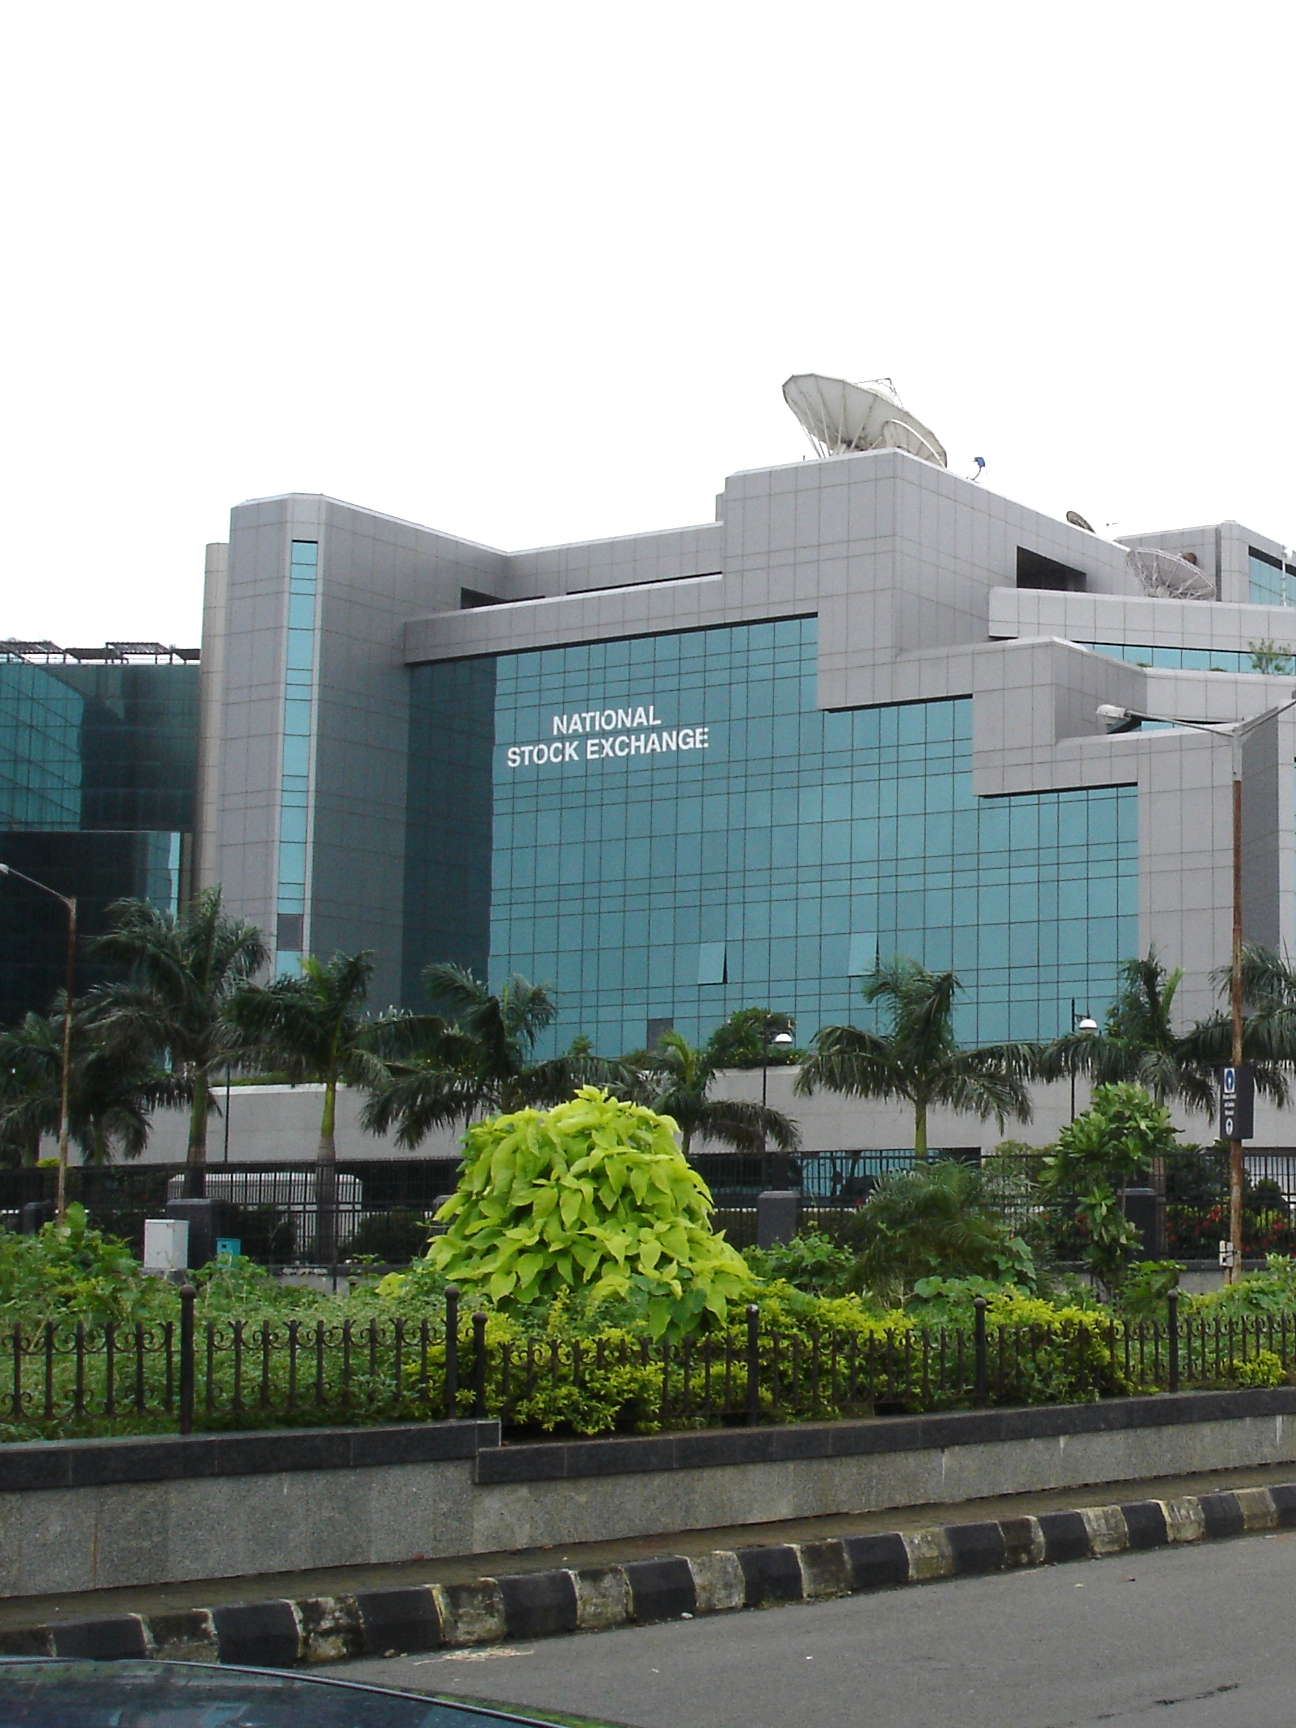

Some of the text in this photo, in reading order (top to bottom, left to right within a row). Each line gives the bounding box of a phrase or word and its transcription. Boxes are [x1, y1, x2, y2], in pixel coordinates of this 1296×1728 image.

[552, 705, 662, 736] NATIONAL
[507, 727, 710, 768] STOCK EXCHANGE
